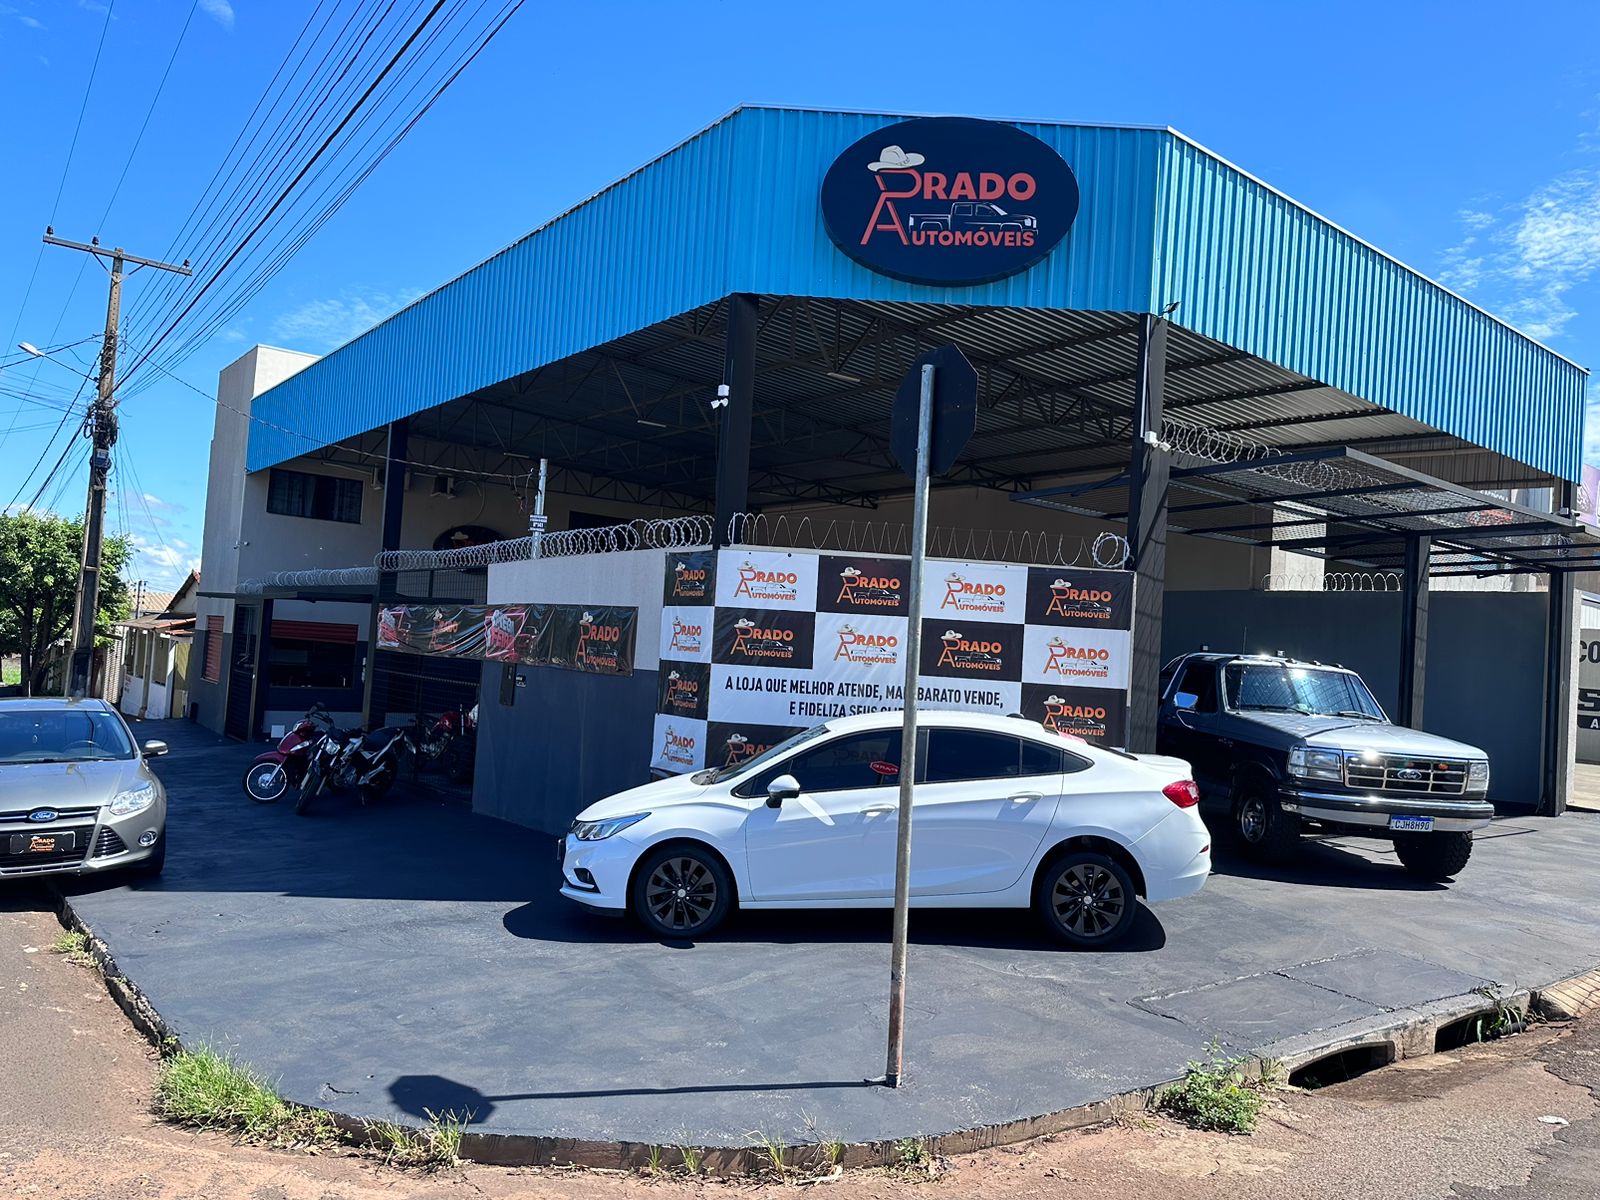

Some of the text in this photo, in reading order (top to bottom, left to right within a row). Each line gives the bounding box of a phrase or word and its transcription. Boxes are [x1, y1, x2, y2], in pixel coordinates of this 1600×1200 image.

[874, 168, 1037, 201] PRADO
[860, 195, 1035, 247] AUTOMÓVEIS
[675, 569, 706, 581] PRADO
[740, 569, 798, 585] PRADO
[843, 575, 901, 590] PRADO
[946, 580, 1006, 596] PRADO
[1052, 586, 1112, 602] PRADO
[580, 623, 620, 642] PRADO
[673, 624, 702, 636] PRADO
[736, 626, 794, 642] PRADO
[840, 632, 898, 648] PRADO
[943, 639, 1003, 654] PRADO
[1049, 645, 1110, 661] PRADO
[669, 679, 698, 693] PRADO
[725, 676, 733, 690] A
[736, 677, 763, 692] LOJA
[766, 679, 787, 693] QUE
[790, 680, 835, 696] MELHOR
[837, 683, 883, 701] ATENDE,
[917, 687, 961, 704] BARATO
[964, 690, 1003, 709] VENDE,
[789, 701, 797, 716] E
[799, 702, 846, 718] FIDELIZA
[1045, 703, 1106, 719] PRADO
[665, 732, 695, 749] PRADO
[729, 741, 775, 755] PRA
